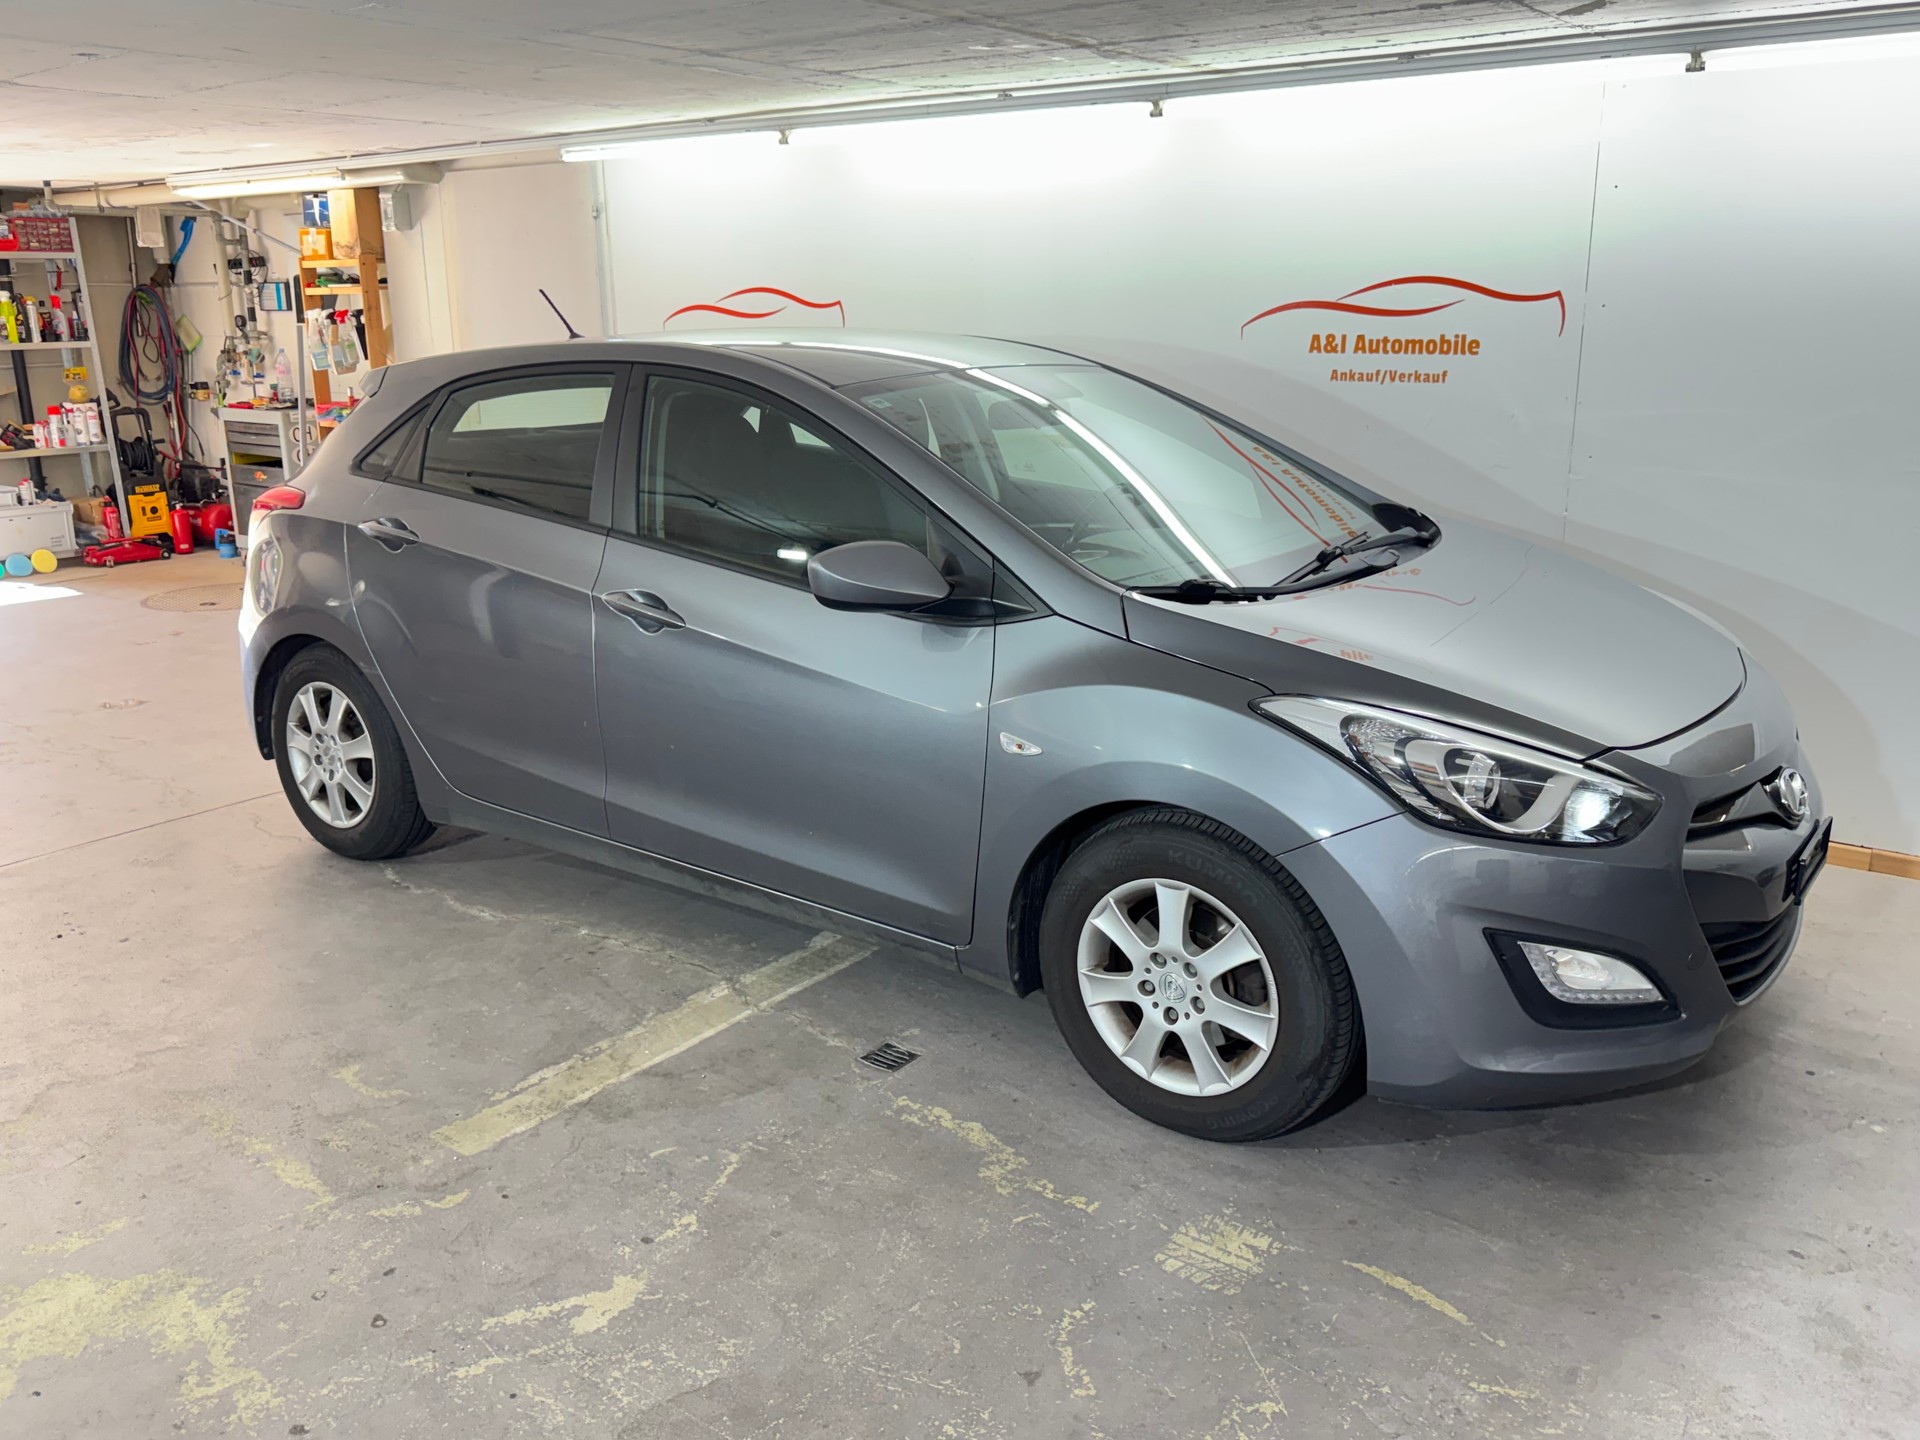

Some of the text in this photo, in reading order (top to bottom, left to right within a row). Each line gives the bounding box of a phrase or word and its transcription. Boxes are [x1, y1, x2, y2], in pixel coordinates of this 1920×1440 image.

[1308, 333, 1481, 356] A&I Automobile
[1330, 369, 1448, 385] Ankauf/Verkauf
